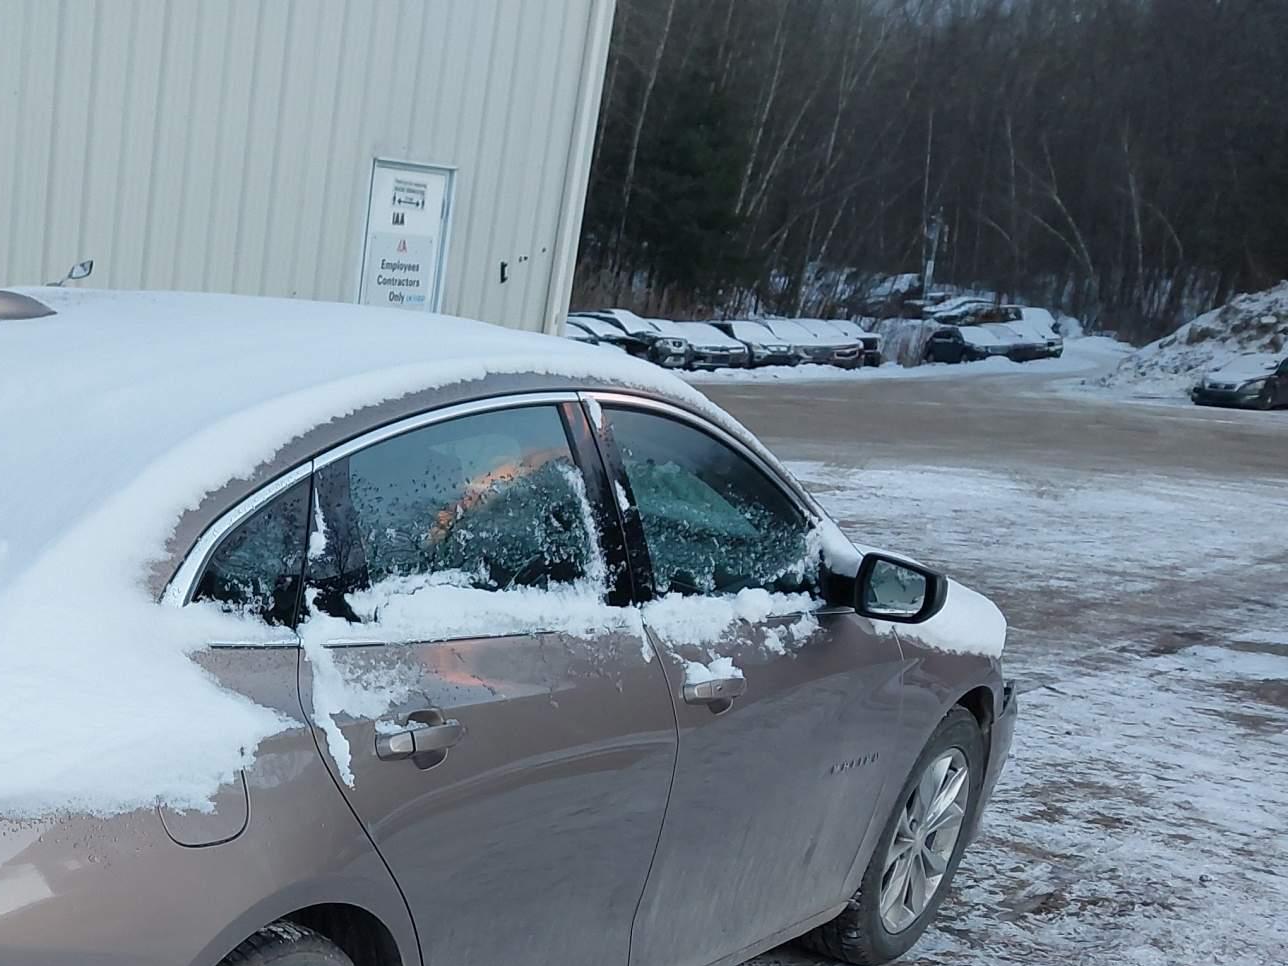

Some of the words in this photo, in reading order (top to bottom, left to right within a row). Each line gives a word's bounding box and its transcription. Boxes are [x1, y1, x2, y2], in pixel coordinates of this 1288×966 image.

[392, 212, 405, 225] IAA
[380, 258, 420, 273] Employees
[376, 274, 420, 287] Contractors
[388, 291, 405, 304] Only
